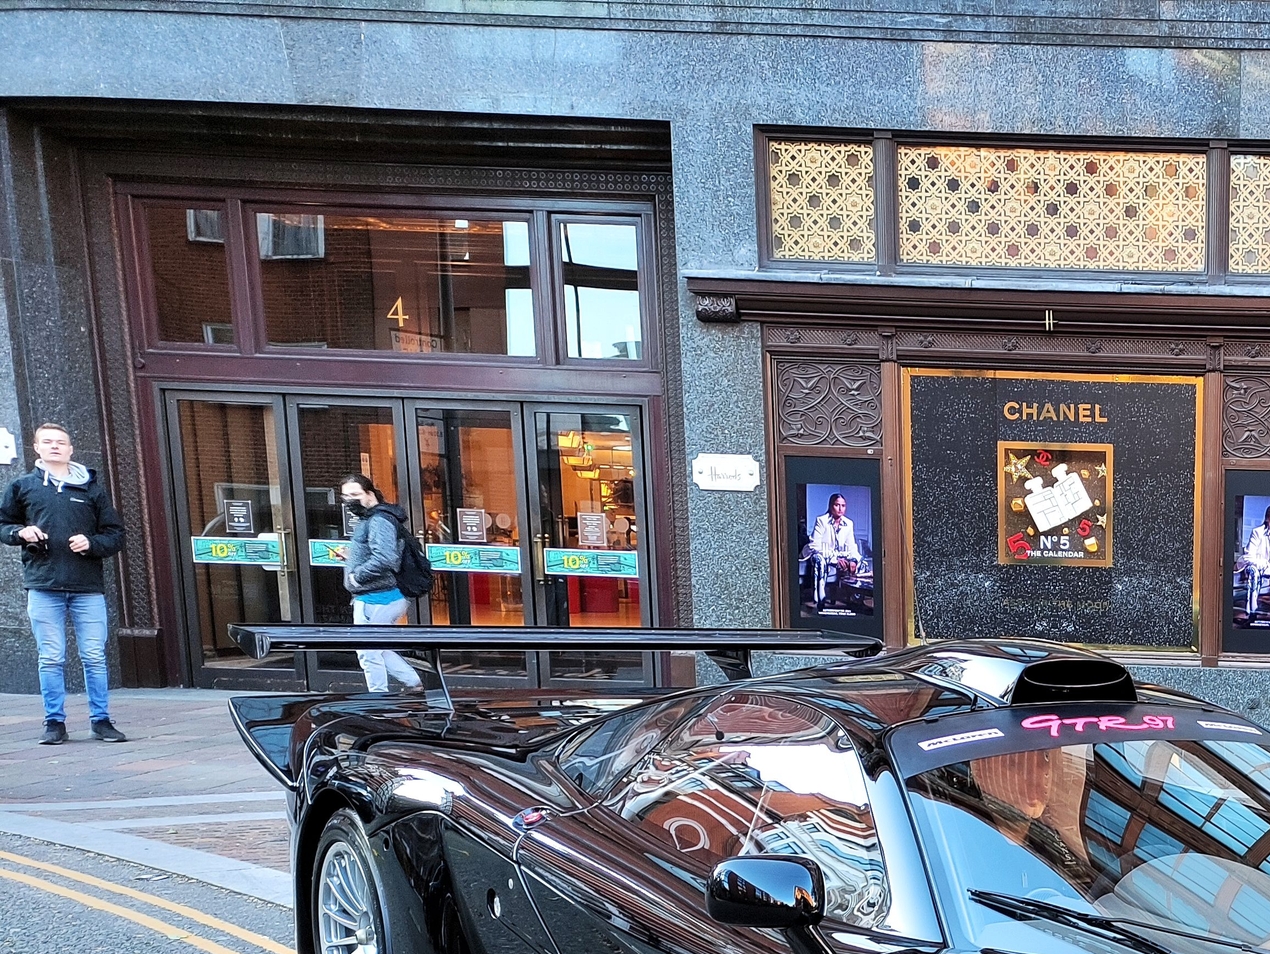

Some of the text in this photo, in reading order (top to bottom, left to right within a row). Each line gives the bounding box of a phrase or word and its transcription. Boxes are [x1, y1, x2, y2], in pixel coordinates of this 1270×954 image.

[386, 296, 409, 327] 4
[1003, 401, 1108, 423] CHANEL
[708, 465, 742, 482] Harrods
[445, 550, 470, 565] 10%
[563, 555, 588, 569] 10%
[1043, 550, 1084, 558] CALENDAR
[1020, 714, 1149, 737] GTR
[926, 731, 999, 748] McLaren
